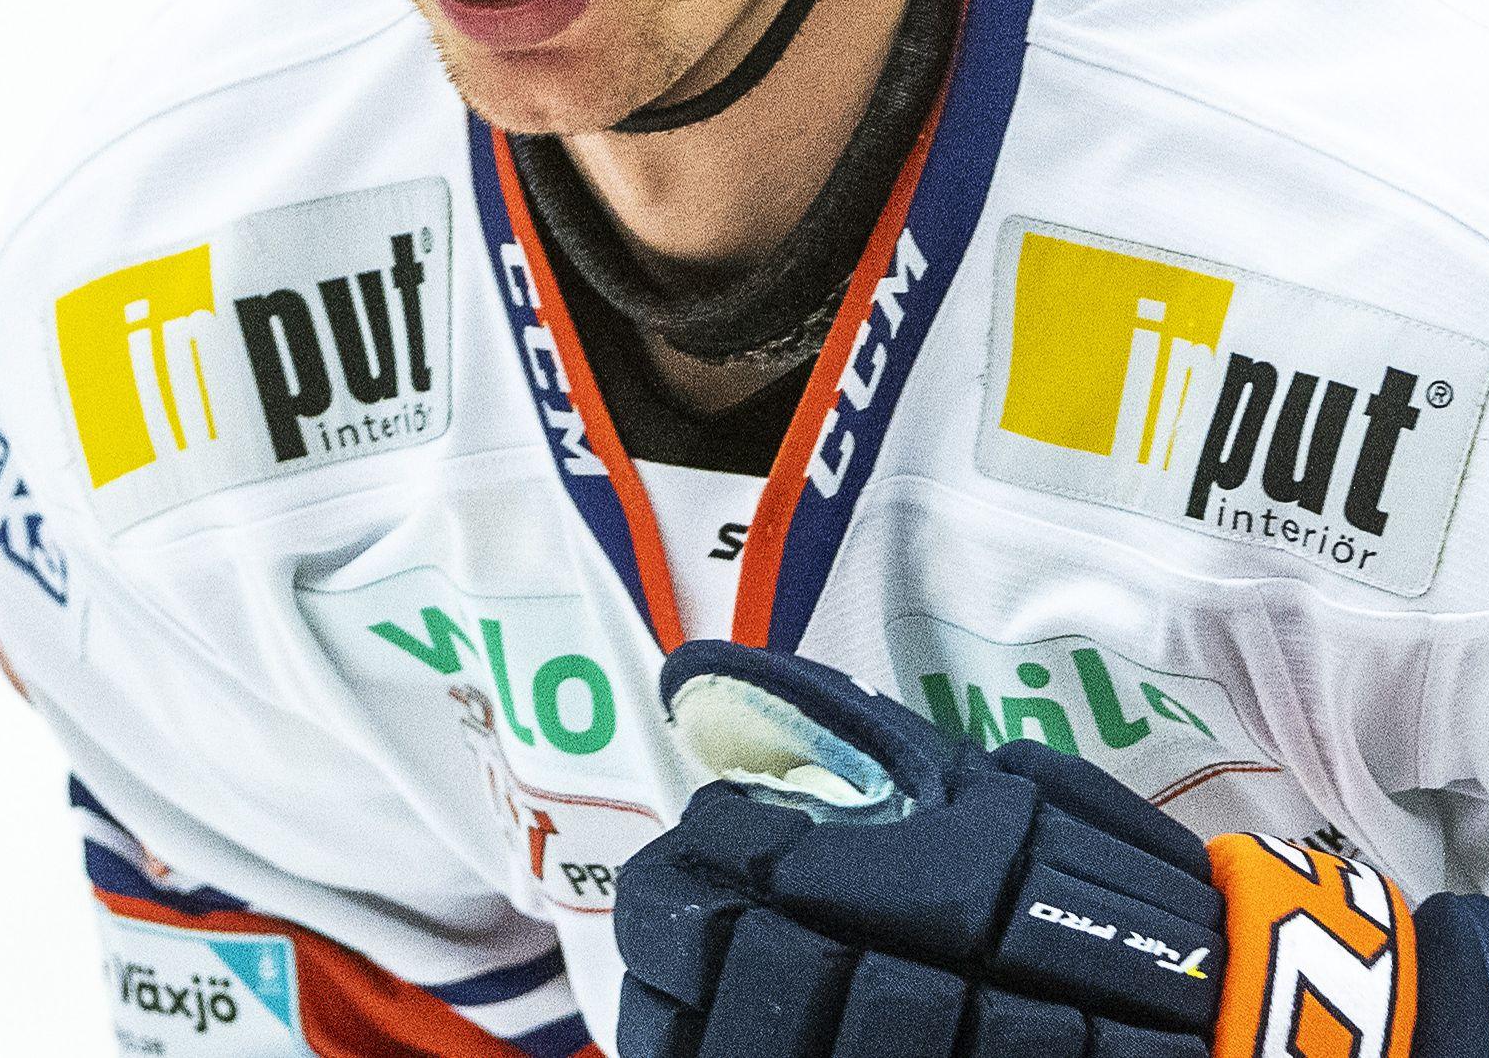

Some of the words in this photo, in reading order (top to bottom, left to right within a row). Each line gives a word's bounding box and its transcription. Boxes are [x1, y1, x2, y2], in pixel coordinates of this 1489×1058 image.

[500, 241, 610, 478] CCM
[804, 226, 929, 500] CCM
[1215, 498, 1377, 573] interiör
